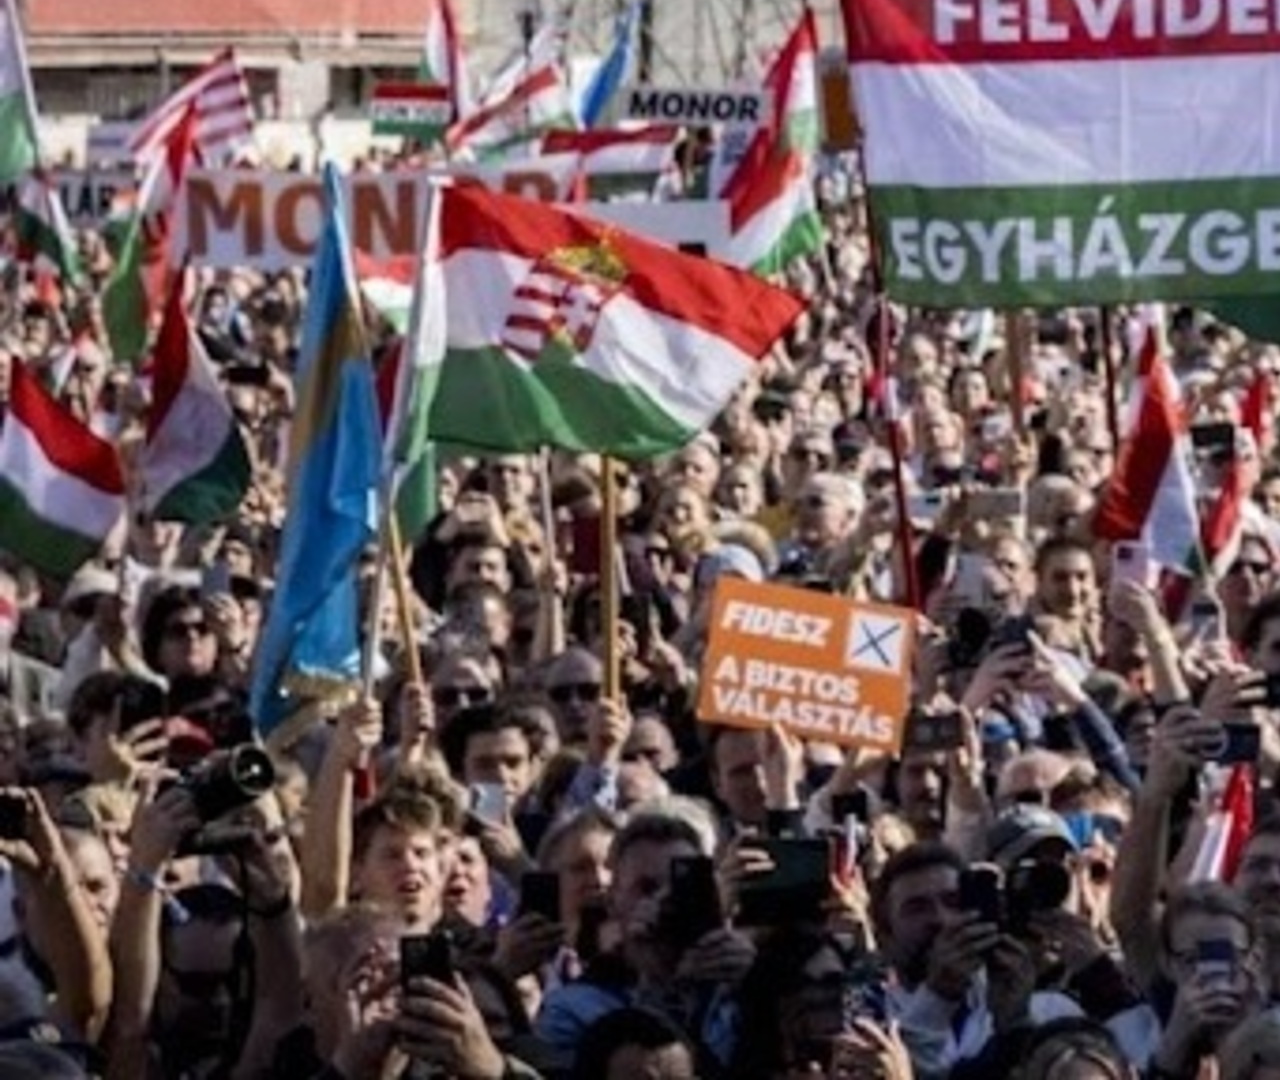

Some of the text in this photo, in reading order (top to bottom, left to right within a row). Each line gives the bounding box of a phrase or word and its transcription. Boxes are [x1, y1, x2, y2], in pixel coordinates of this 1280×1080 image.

[629, 91, 759, 120] MONOR
[185, 171, 557, 256] MON
[720, 599, 834, 648] FIDESZ
[714, 654, 861, 704] A BIZTOS
[711, 682, 895, 743] VÁLASZTÁS
